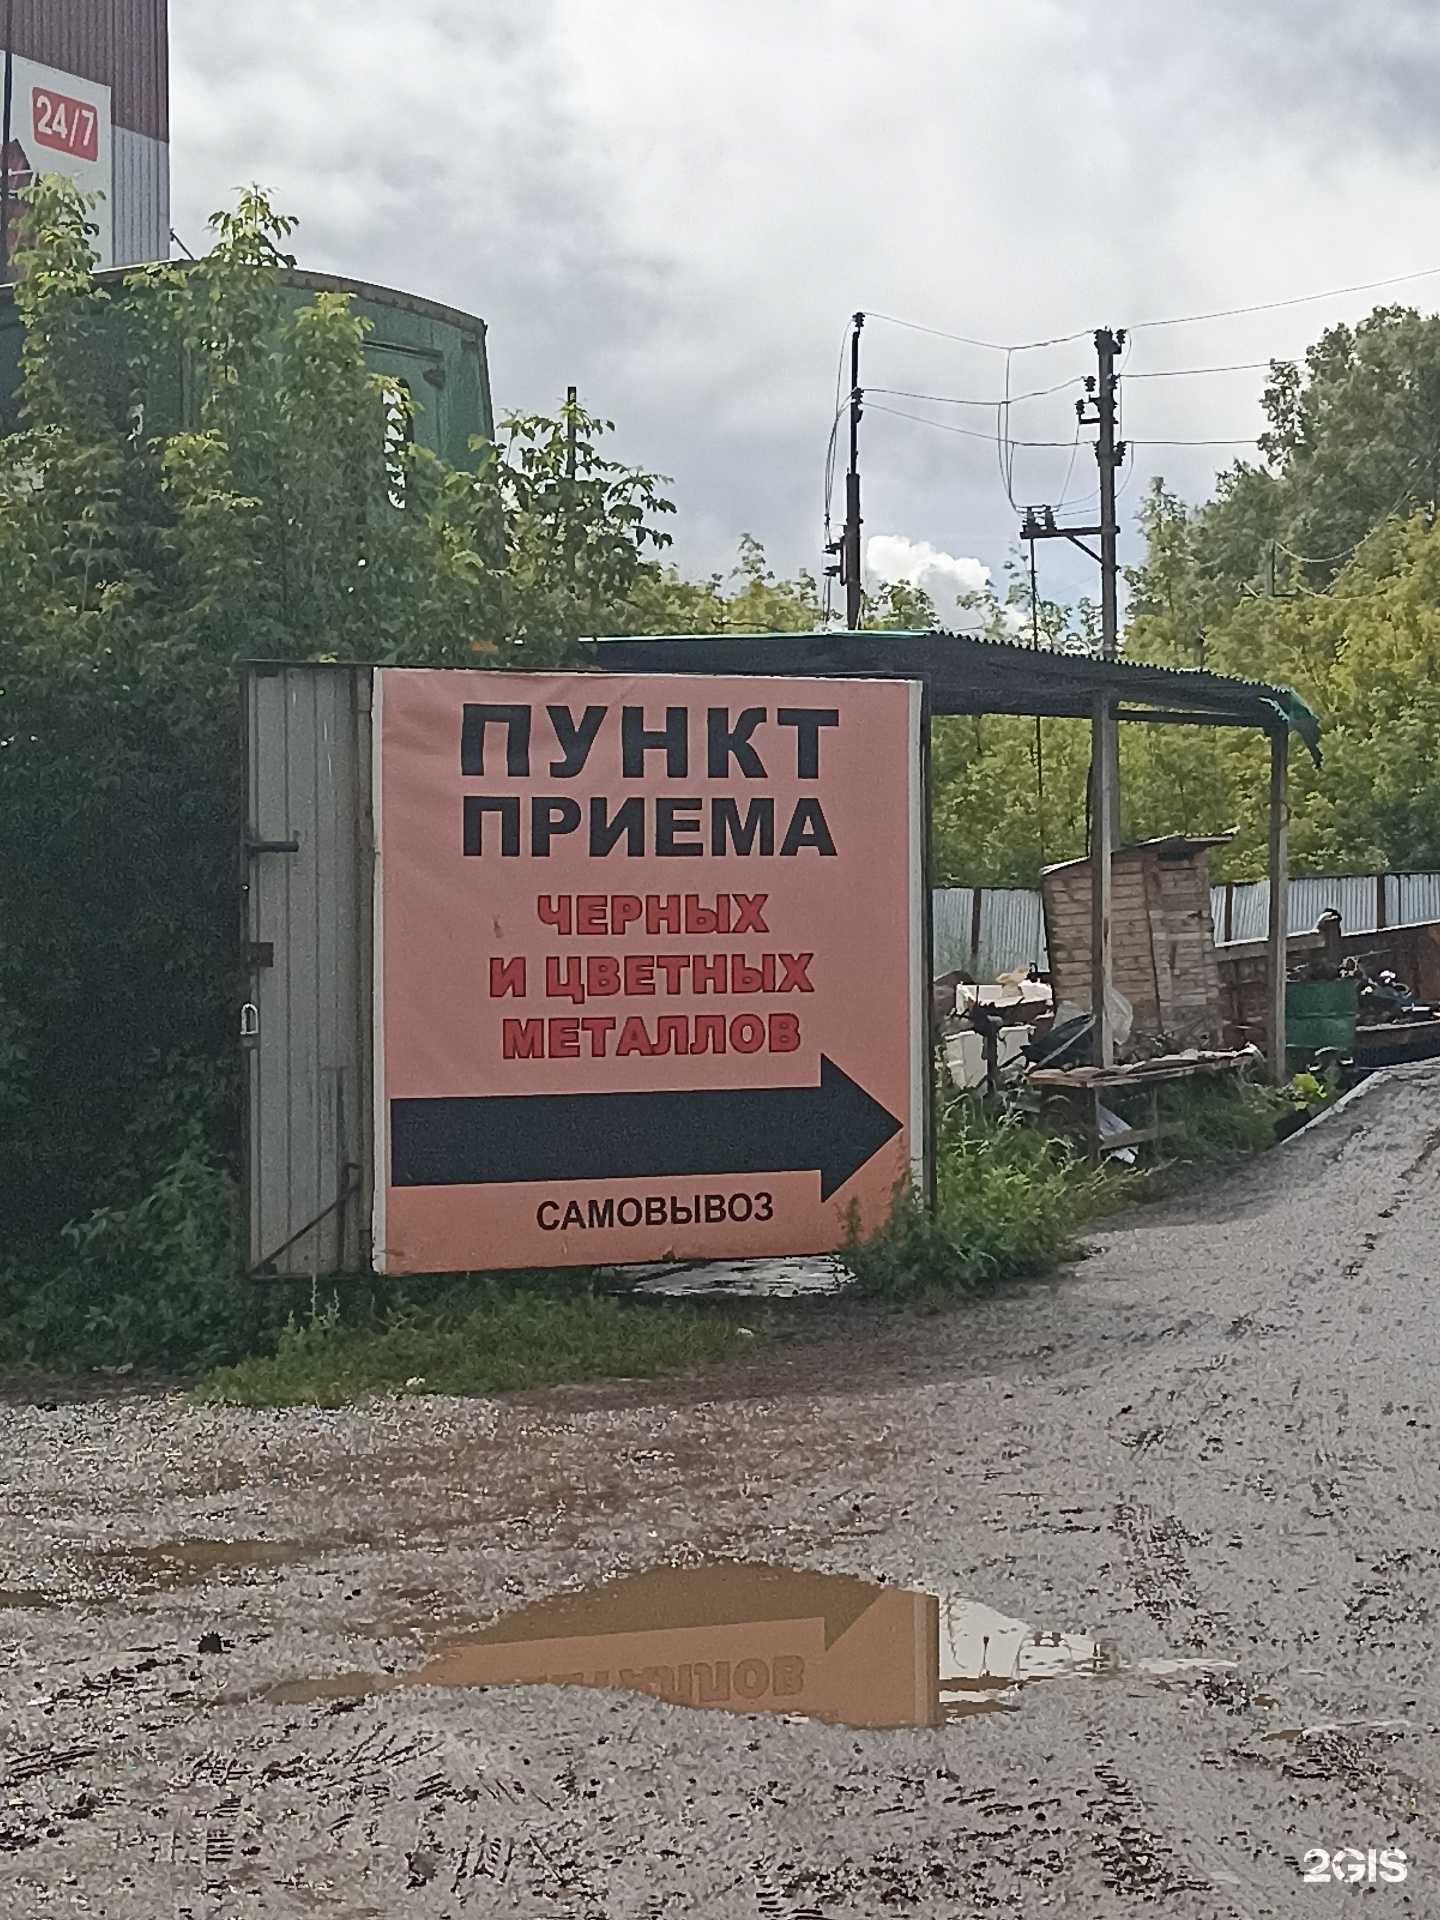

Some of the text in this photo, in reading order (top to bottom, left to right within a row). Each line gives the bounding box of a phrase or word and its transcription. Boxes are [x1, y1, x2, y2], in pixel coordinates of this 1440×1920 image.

[36, 95, 94, 147] 24/7
[461, 703, 839, 779] ПУНКТ
[462, 796, 838, 857] ПРИЕМА
[537, 893, 769, 935] ЧЕРНЫХ
[489, 953, 815, 1004] И ЦВЕТНЫХ
[502, 1013, 801, 1060] МЕТАЛЛОВ
[536, 1192, 773, 1230] САМОВЫВОЗ
